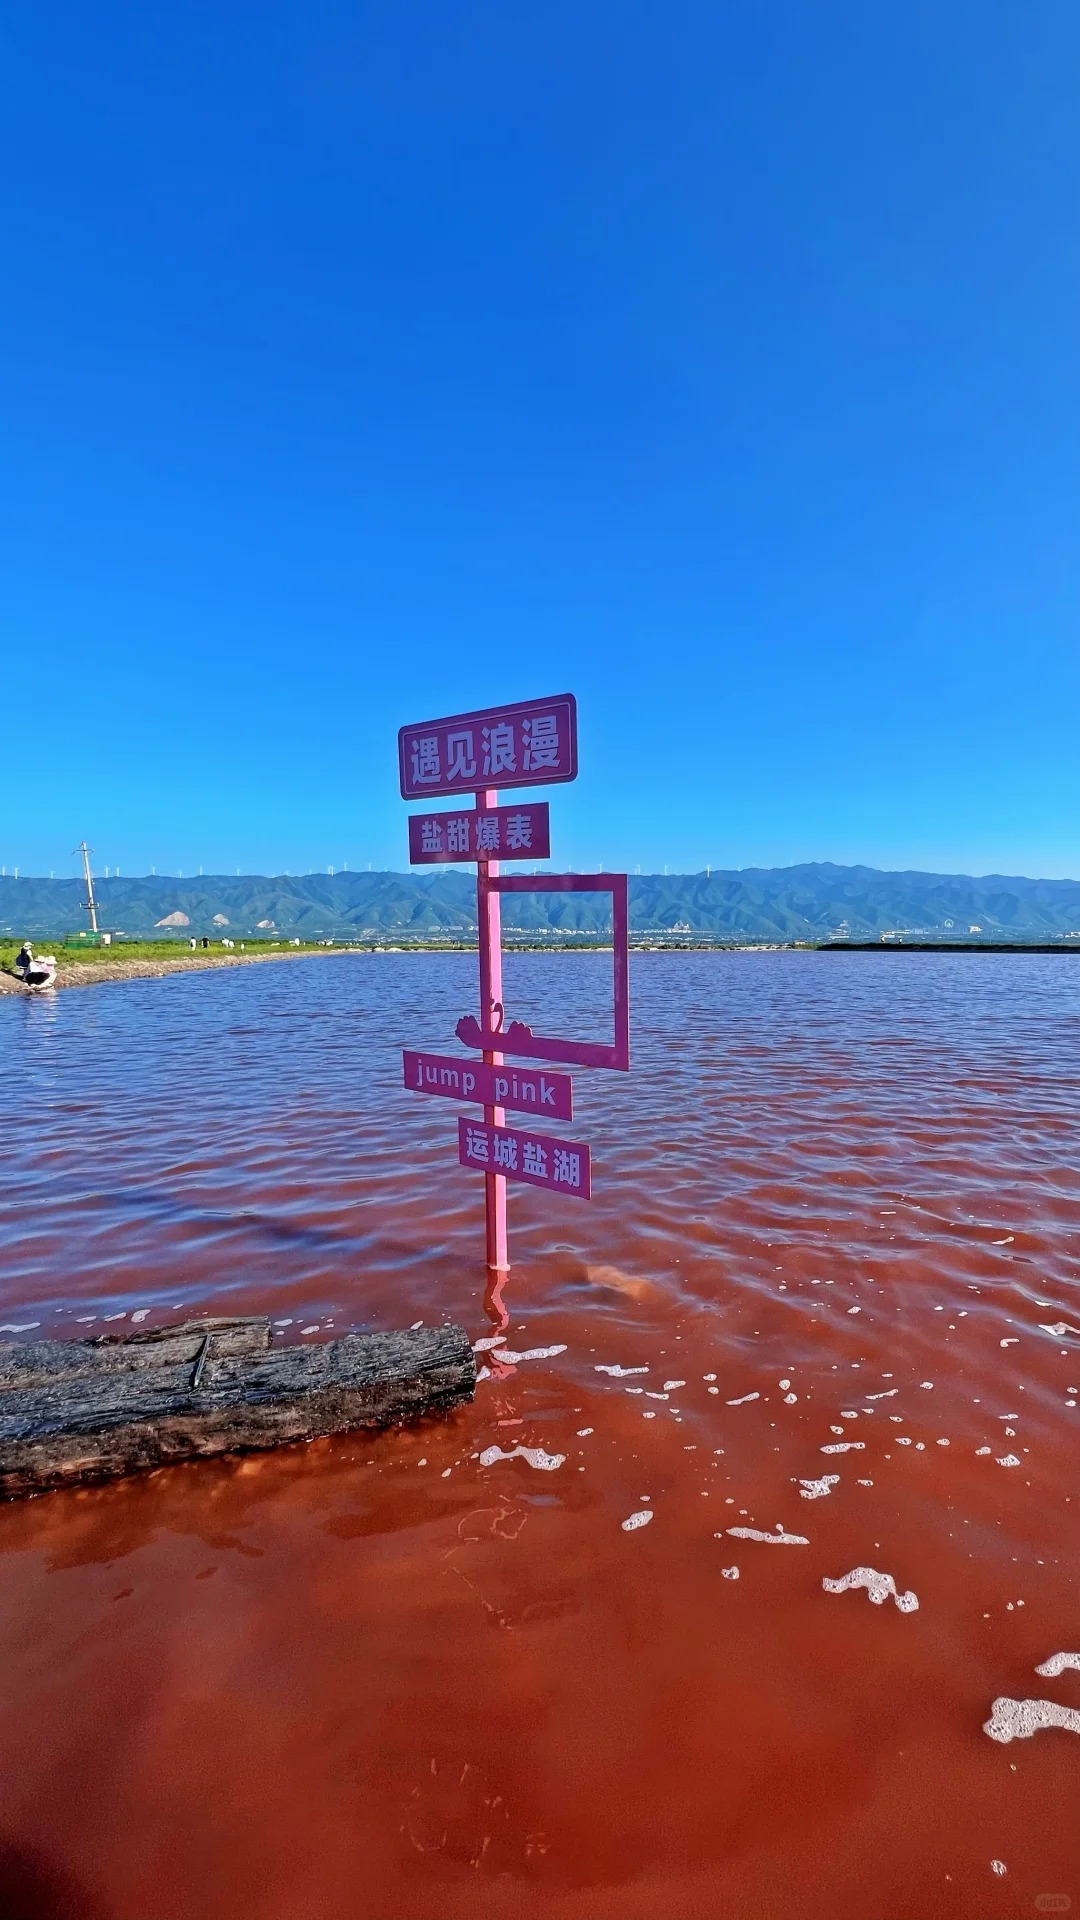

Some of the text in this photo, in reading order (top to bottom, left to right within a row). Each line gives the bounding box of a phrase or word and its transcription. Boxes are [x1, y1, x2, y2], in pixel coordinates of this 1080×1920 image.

[411, 715, 561, 785] 遇见浪漫
[421, 814, 533, 853] 盐甜爆表
[416, 1059, 556, 1106] jump pink
[466, 1127, 580, 1188] 运城盐湖
